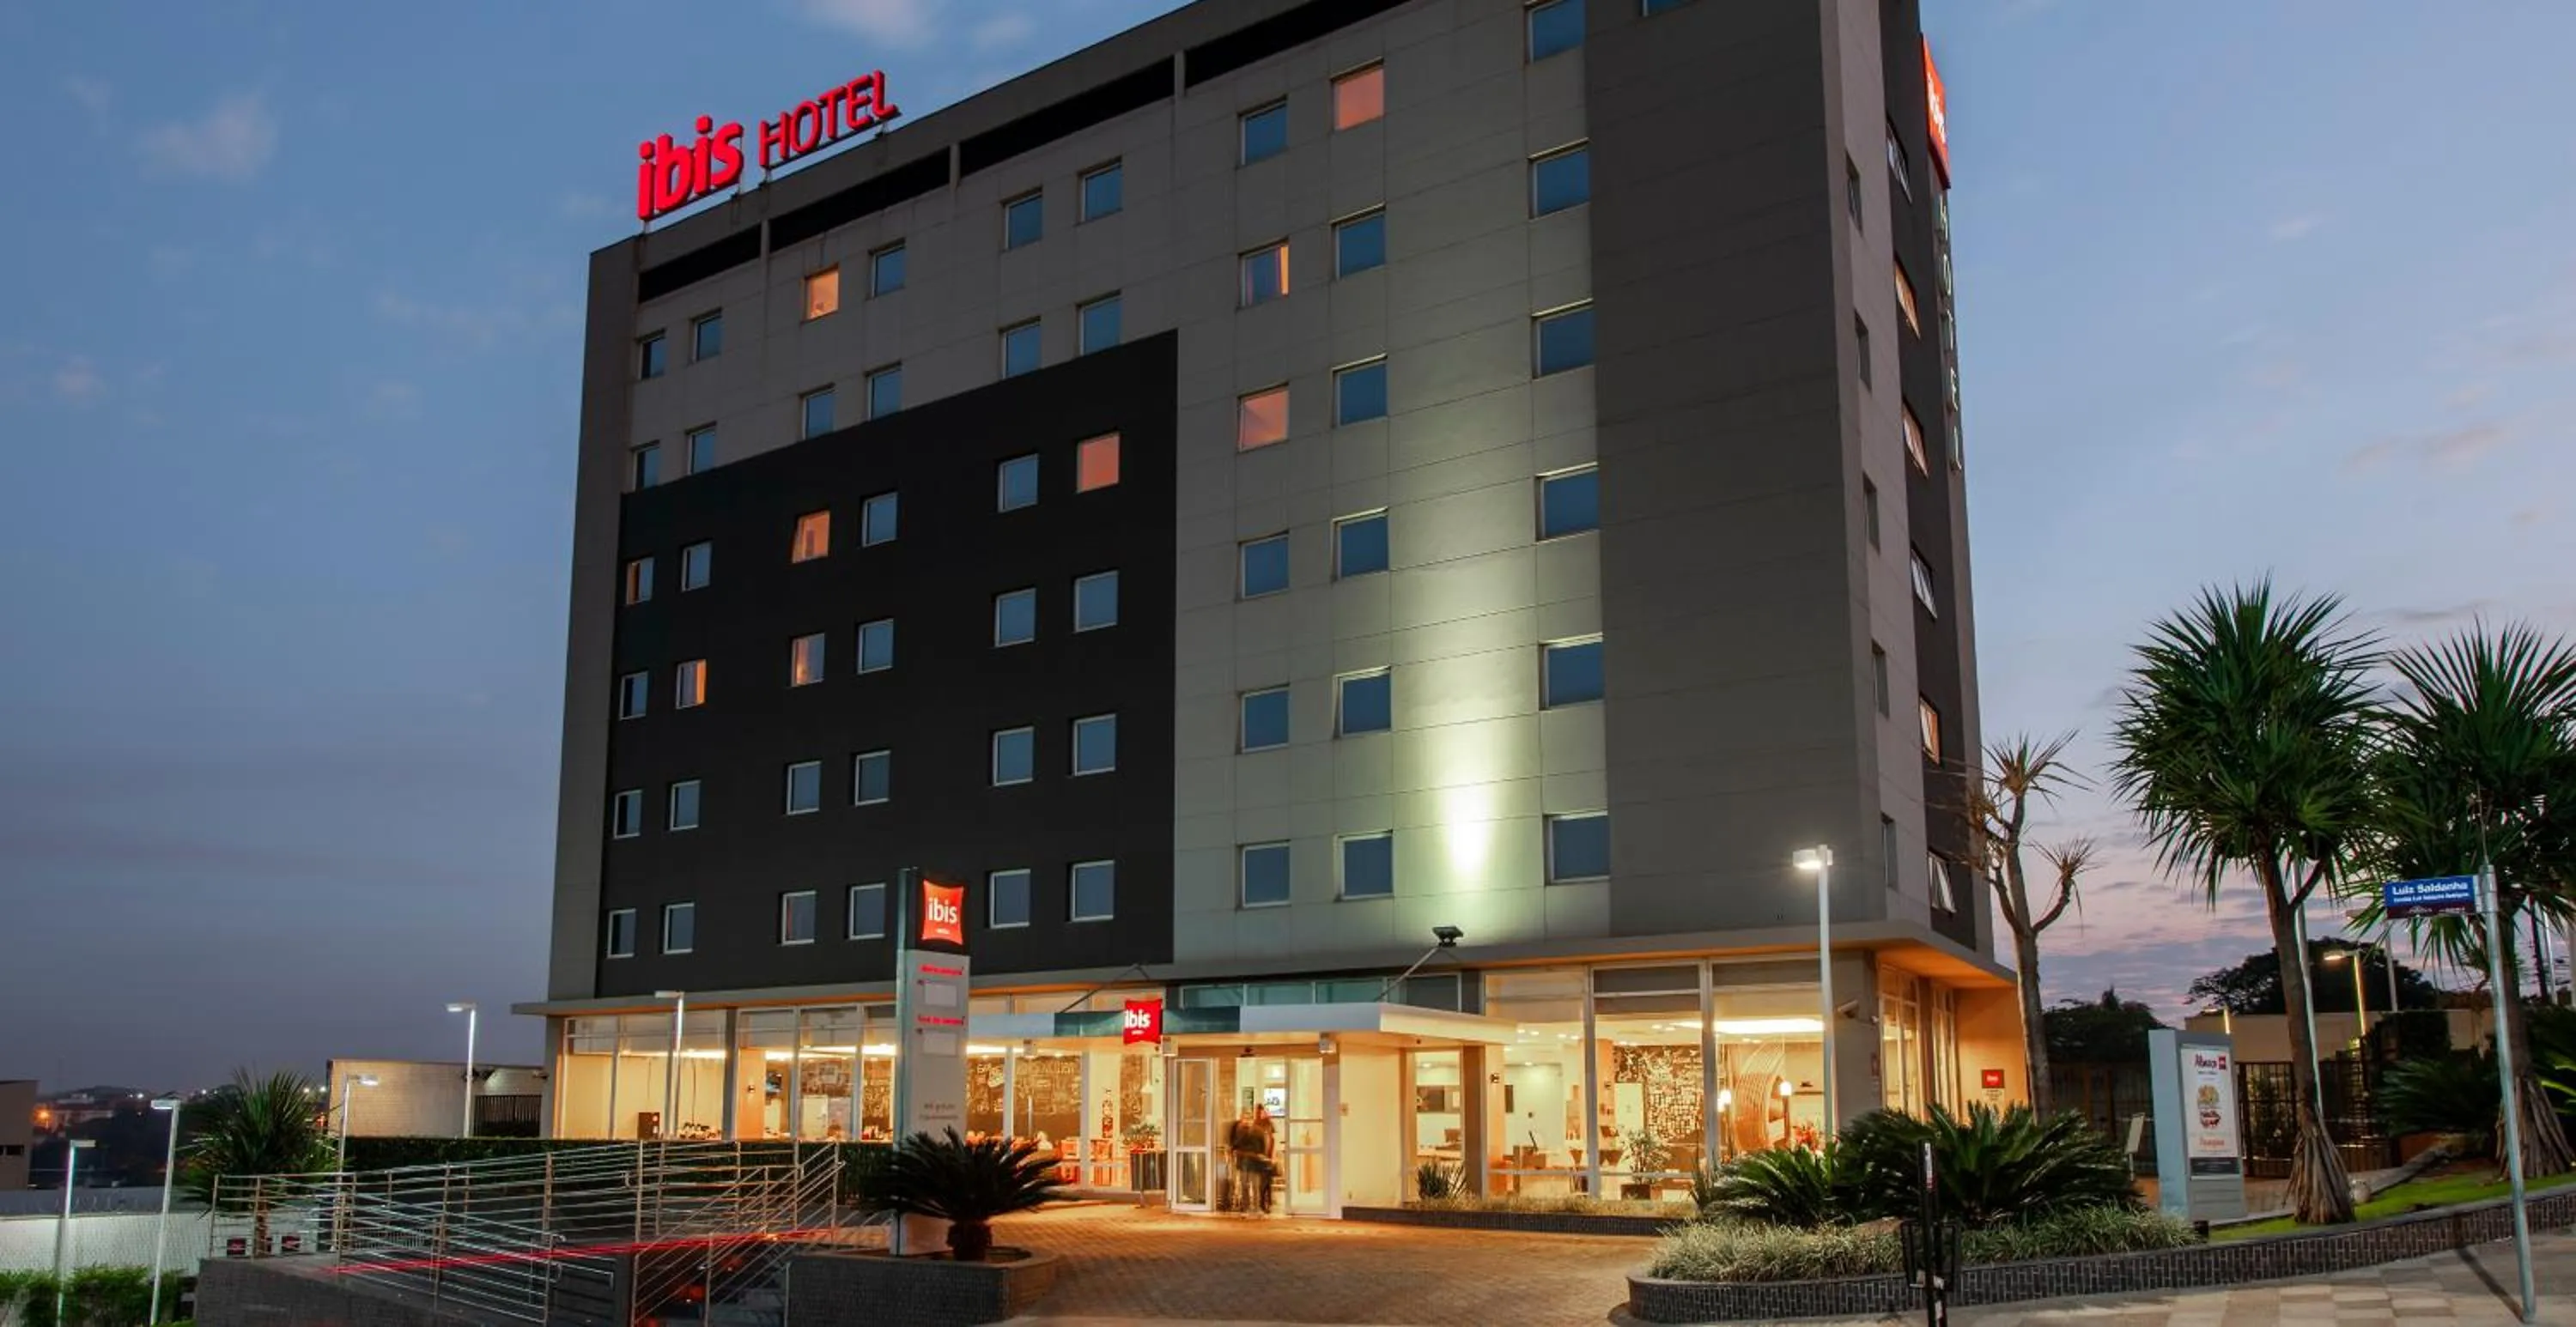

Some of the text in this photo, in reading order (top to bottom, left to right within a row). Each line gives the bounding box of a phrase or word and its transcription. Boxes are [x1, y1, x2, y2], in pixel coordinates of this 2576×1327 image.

[637, 70, 898, 220] ibis HOTEL
[1938, 191, 1963, 470] HOTEL
[928, 897, 958, 924] ibis
[1124, 1009, 1151, 1028] ibis
